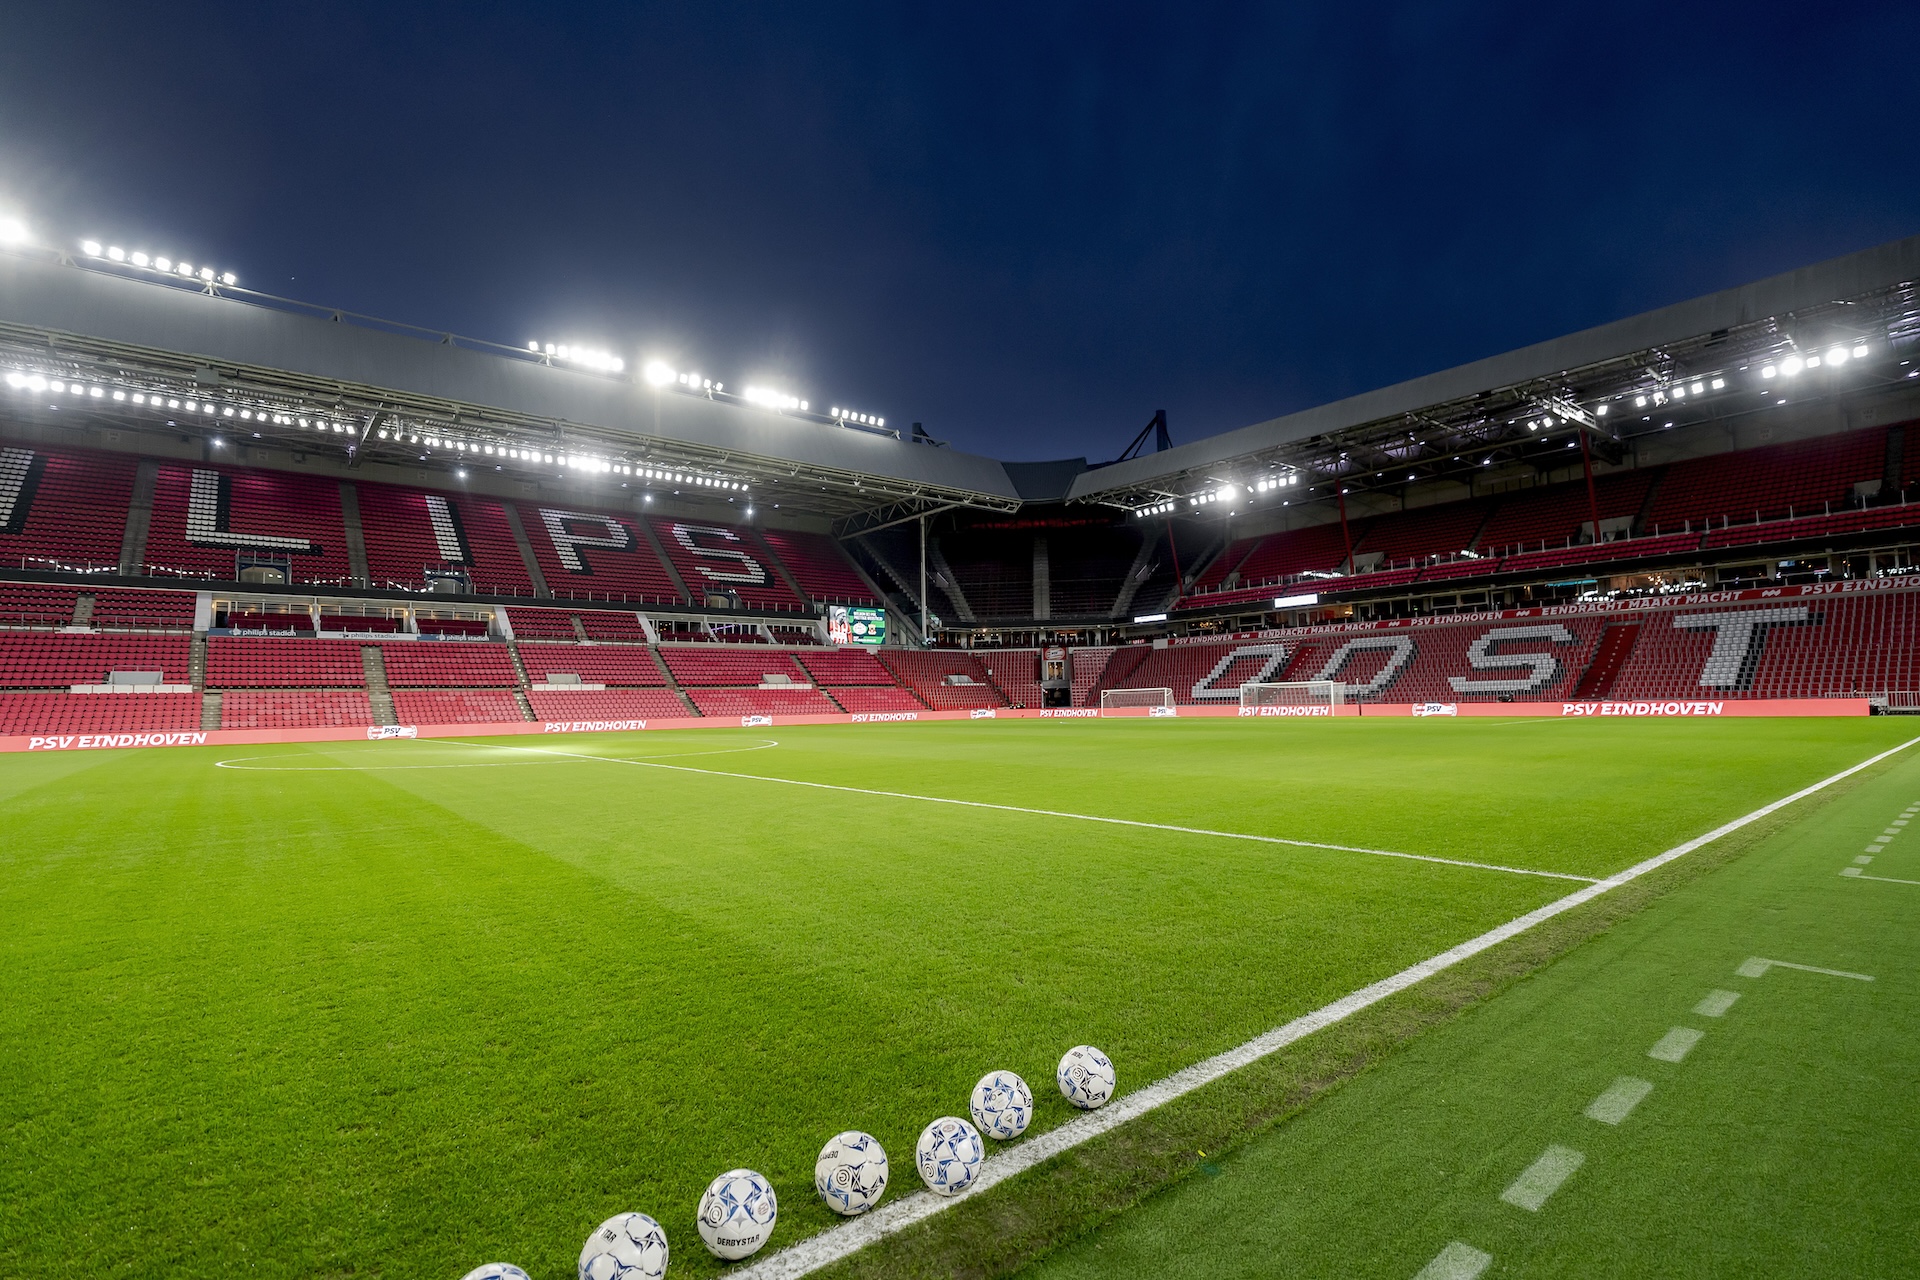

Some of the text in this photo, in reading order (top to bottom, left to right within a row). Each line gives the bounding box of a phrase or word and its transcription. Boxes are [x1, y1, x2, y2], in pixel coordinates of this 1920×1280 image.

[1800, 573, 1920, 596] PSV EINDHO
[1541, 591, 1744, 616] EENDRACHT MAAKT MACHT
[1410, 611, 1503, 626] PSV EINDHOVEN
[242, 629, 268, 637] philips
[1257, 621, 1379, 639] EENDRACHT MAAKT MACHT
[1189, 634, 1234, 644] EINDHOVEN
[1040, 709, 1098, 717] PSV EINDHOVEN
[1238, 705, 1330, 717] PSV EINDHOVEN
[1562, 702, 1724, 716] PSV EINDHOVEN
[851, 712, 918, 722] PSV EINDHOVEN
[544, 720, 647, 733] PSV EINDHOVEN
[28, 732, 207, 750] PSV EINDHOVEN
[716, 1233, 760, 1247] DERBYSTAR
